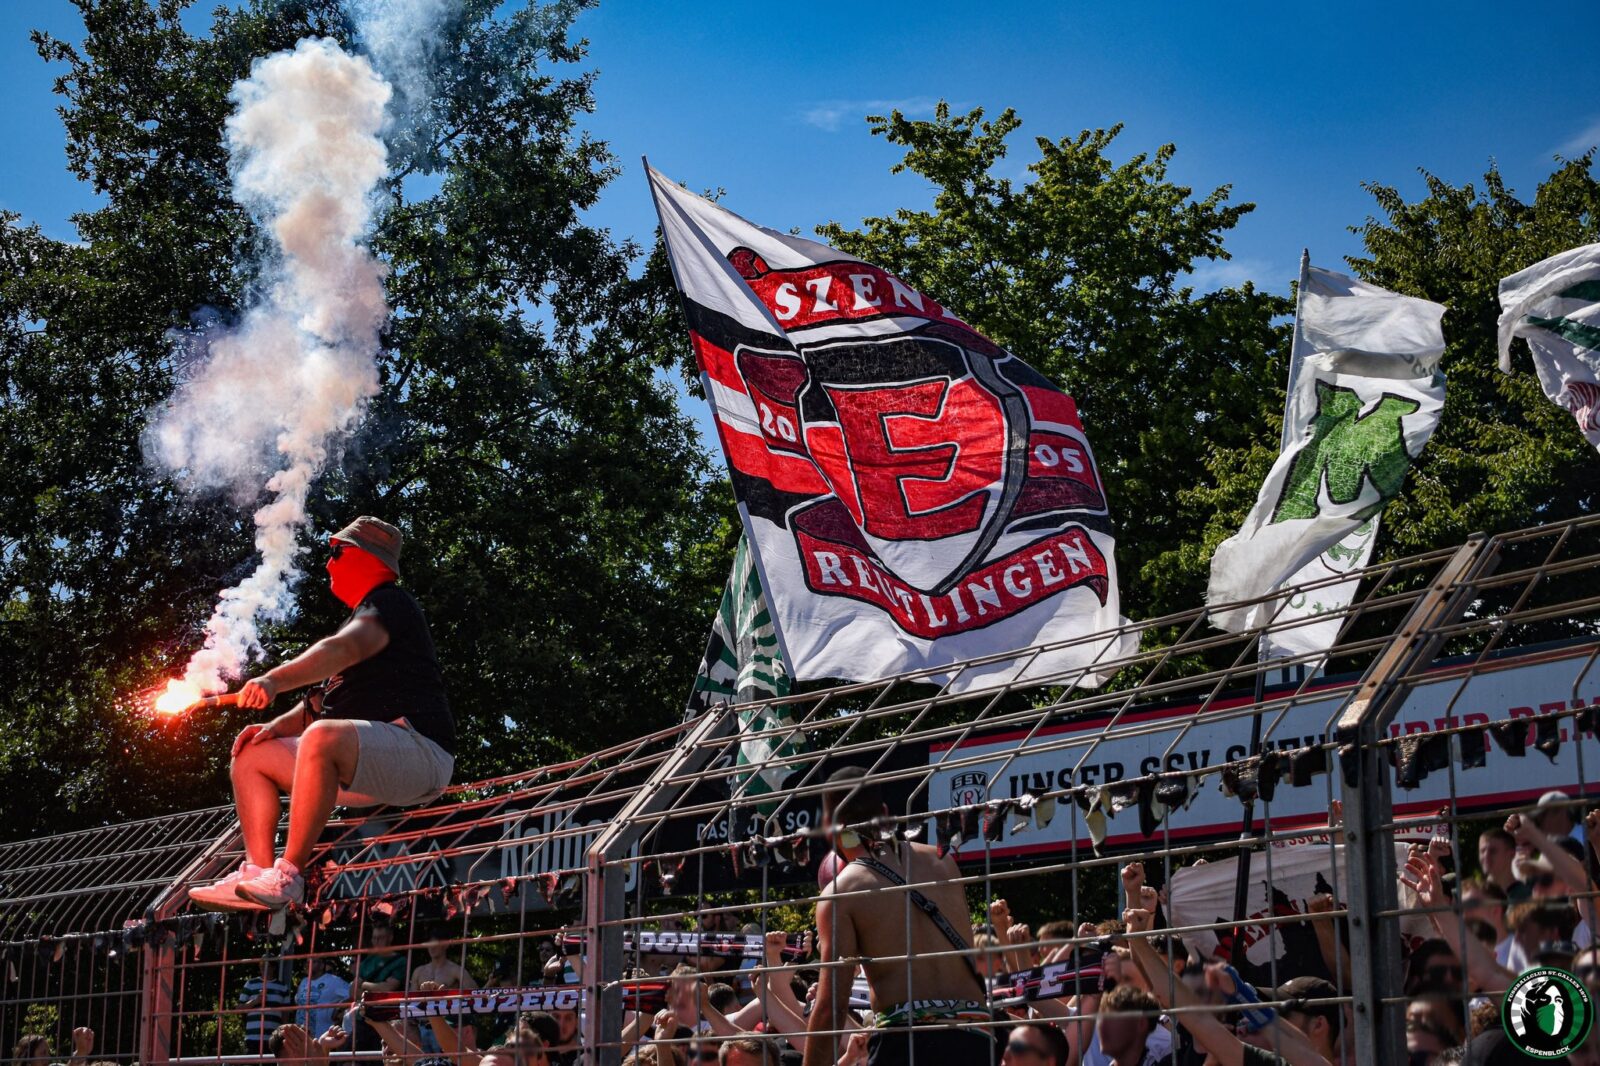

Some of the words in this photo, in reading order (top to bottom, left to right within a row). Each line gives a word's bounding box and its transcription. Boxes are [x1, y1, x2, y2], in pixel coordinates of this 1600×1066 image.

[774, 273, 959, 321] SZEN
[760, 402, 797, 442] 20
[822, 376, 991, 542] E
[1034, 444, 1084, 473] 05
[813, 537, 1093, 629] REUTLINGEN
[953, 773, 987, 790] SSV
[399, 988, 629, 1018] KREUZEIC
